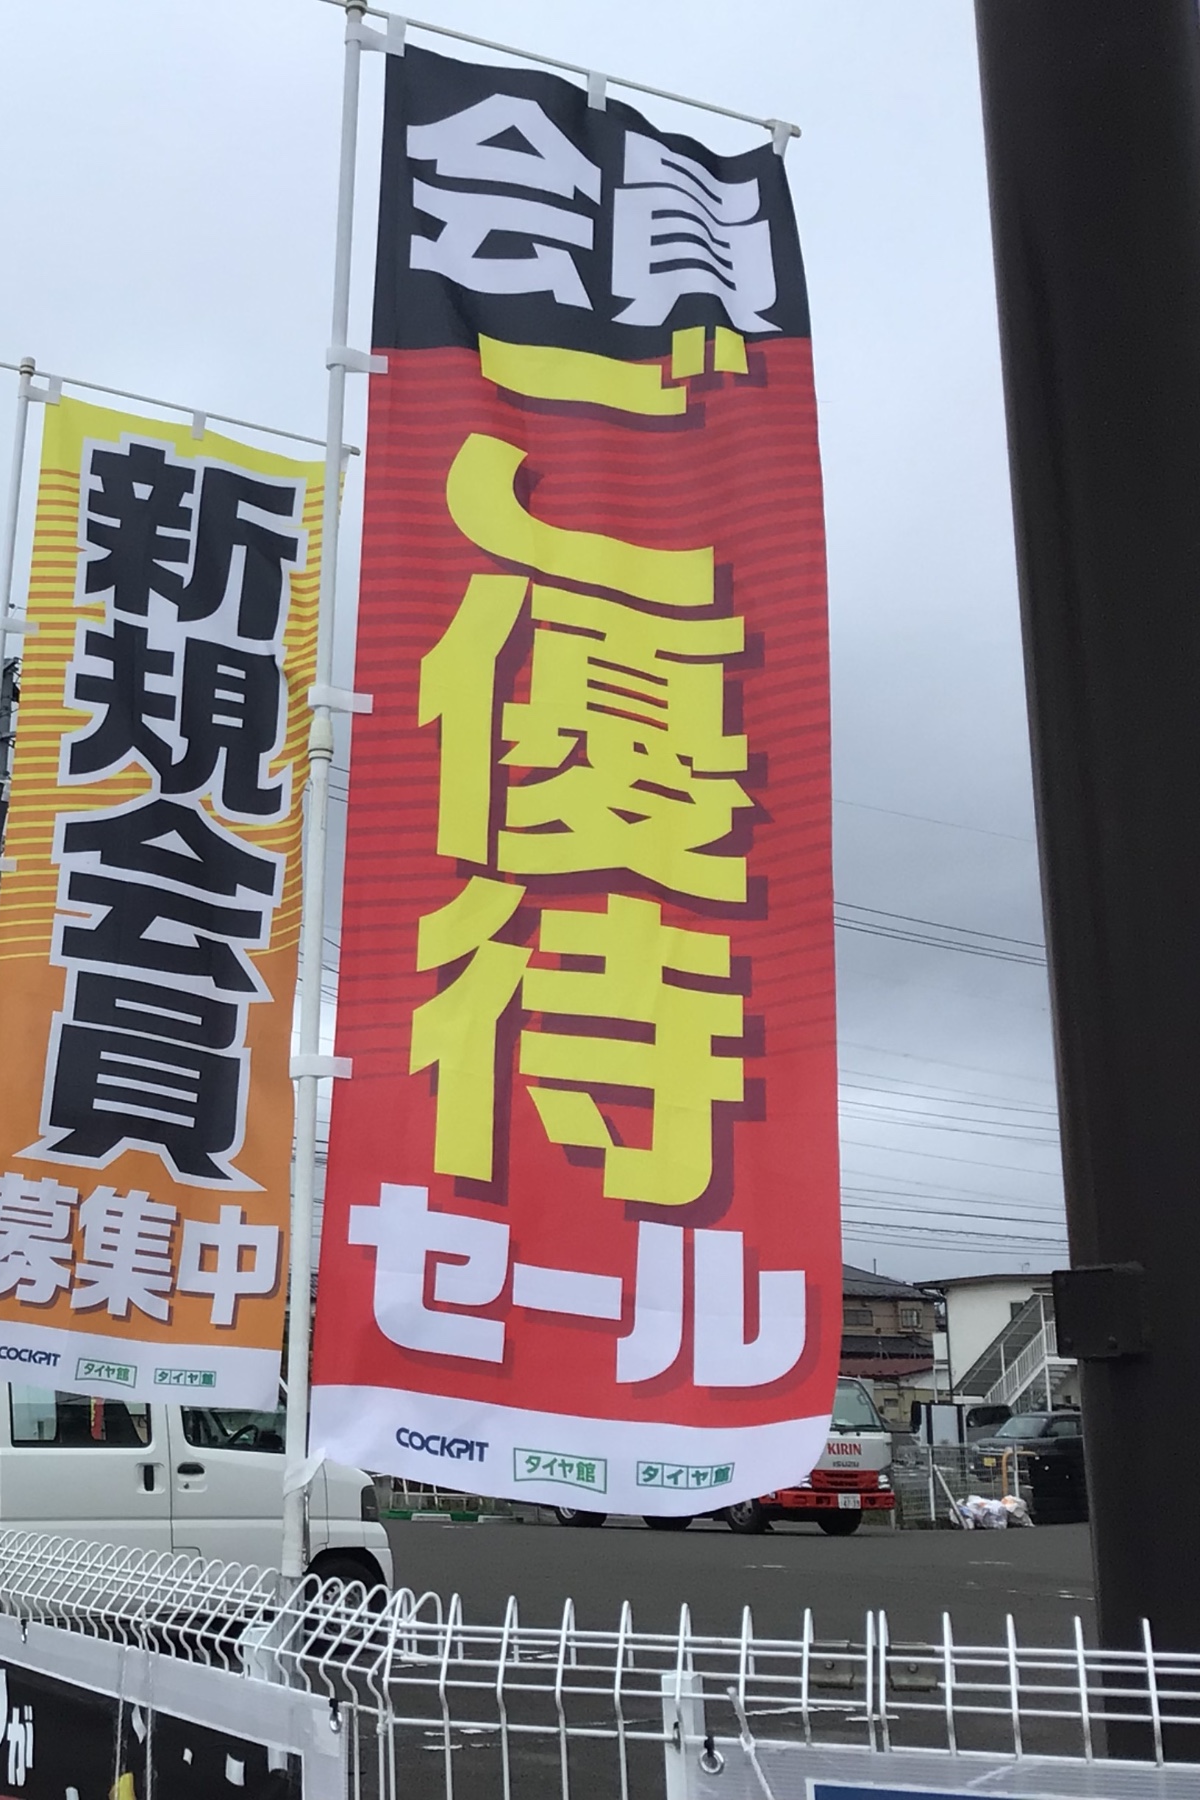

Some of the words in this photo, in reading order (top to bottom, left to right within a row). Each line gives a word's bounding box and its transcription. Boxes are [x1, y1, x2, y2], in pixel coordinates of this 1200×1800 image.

[406, 93, 782, 333] 会員
[409, 325, 755, 1206] ご優待
[47, 443, 300, 1181] 新規会員
[348, 1182, 806, 1387] セール
[83, 1362, 131, 1383] タイヤ館
[157, 1370, 215, 1386] タイヤ館
[396, 1427, 489, 1462] COCKPIT
[827, 1443, 862, 1455] KIRIN
[525, 1456, 596, 1484] タイヤ館
[641, 1464, 733, 1485] タイヤ館
